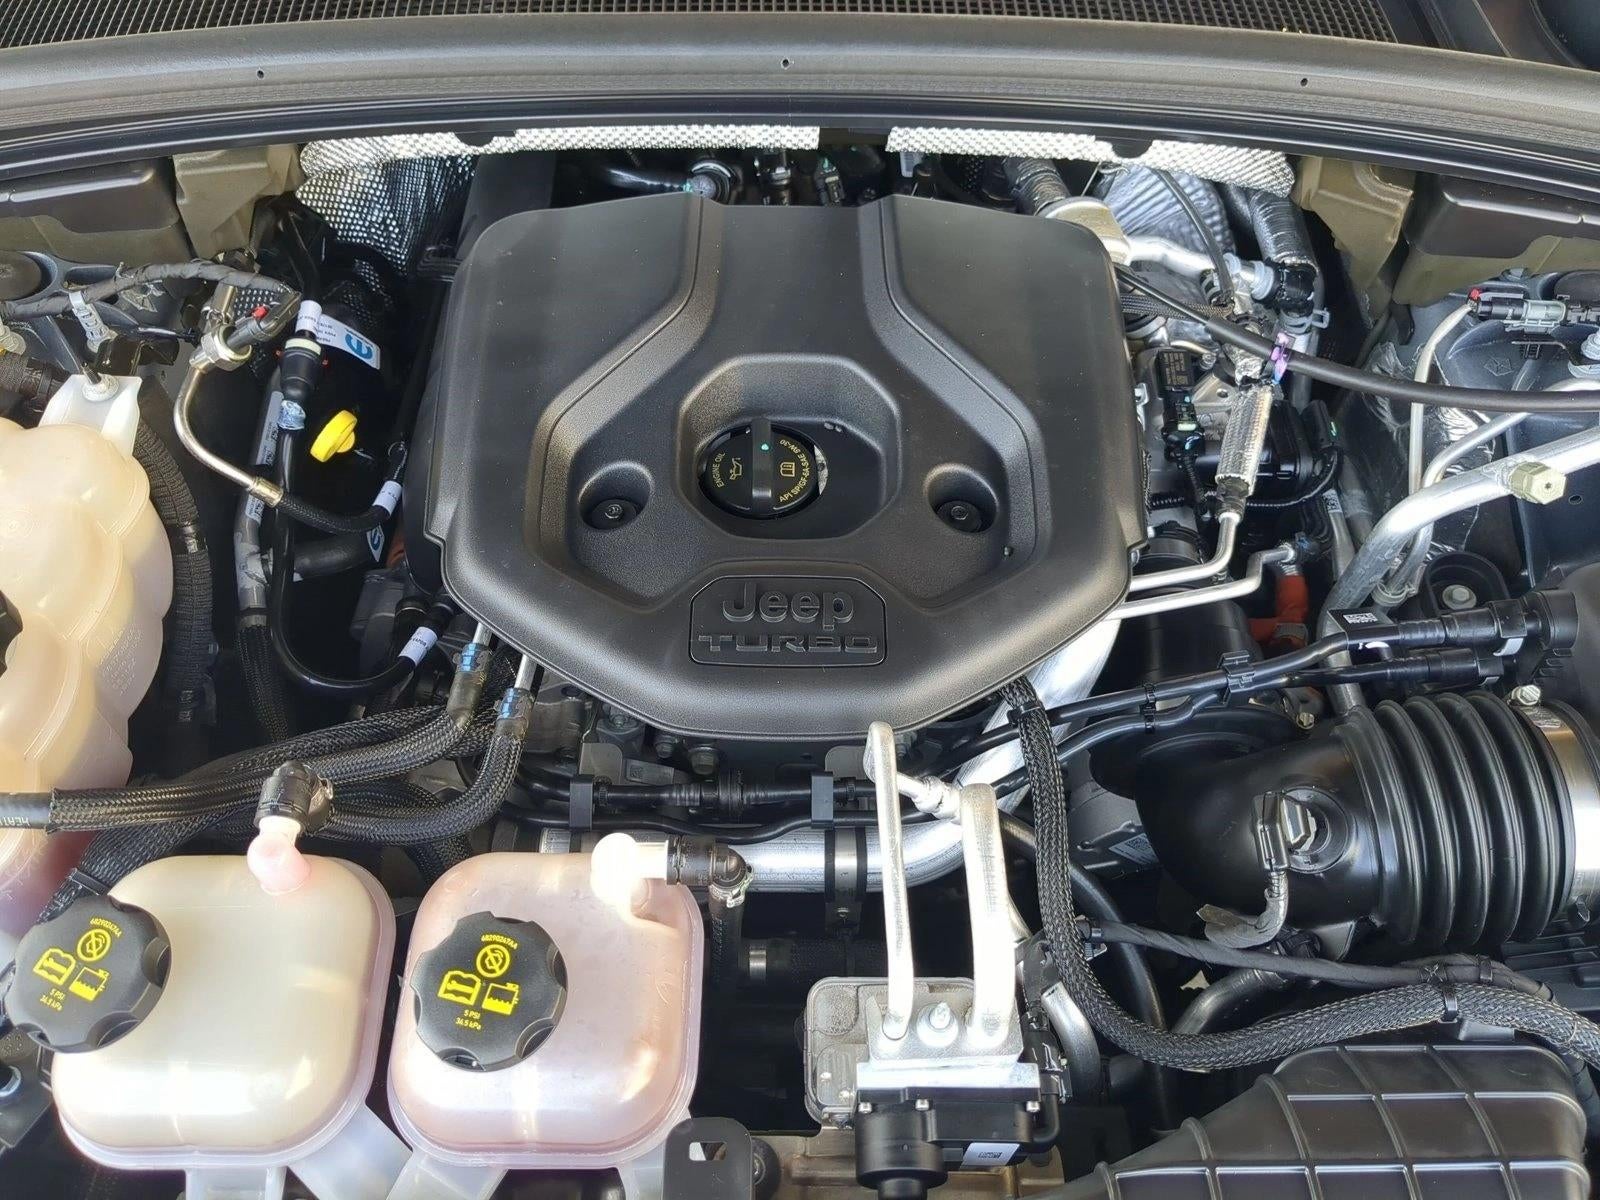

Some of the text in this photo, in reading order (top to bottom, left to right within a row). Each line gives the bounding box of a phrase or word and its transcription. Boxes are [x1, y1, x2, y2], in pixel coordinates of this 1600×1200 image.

[711, 452, 726, 488] ENGINE OIL
[779, 492, 794, 503] API
[722, 582, 854, 632] Jeep
[698, 634, 878, 654] TURBO
[468, 1010, 481, 1020] PSI
